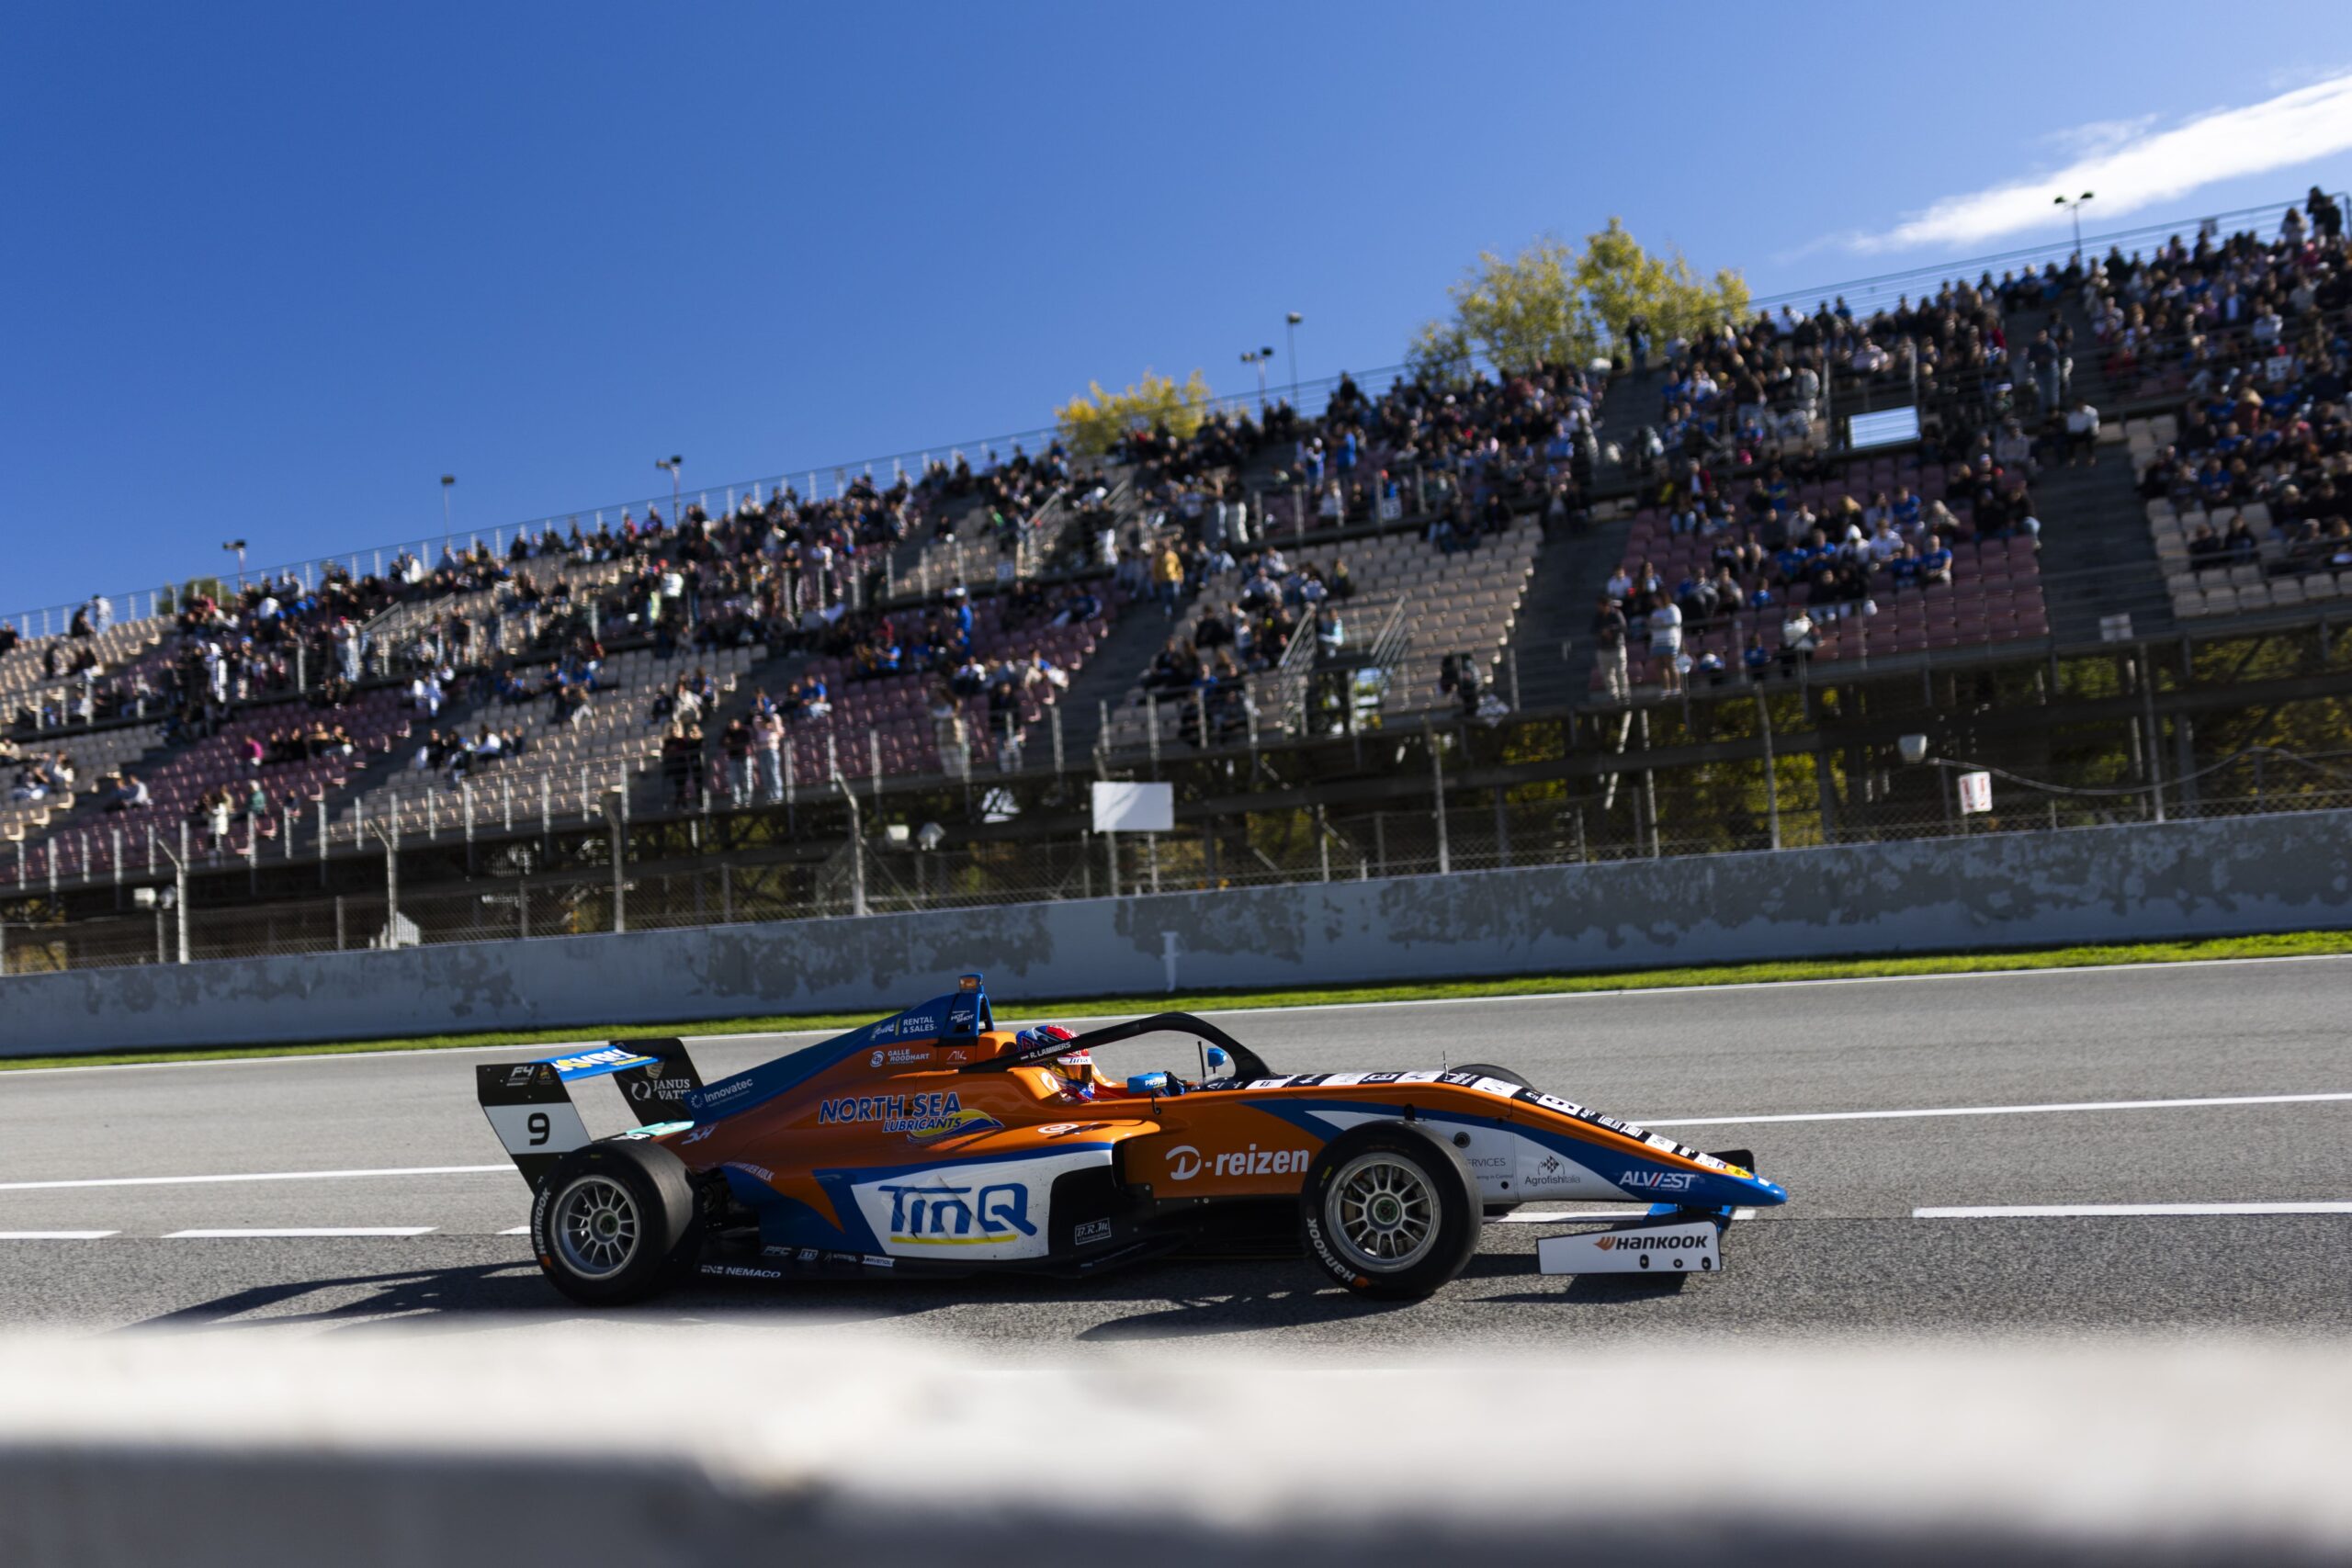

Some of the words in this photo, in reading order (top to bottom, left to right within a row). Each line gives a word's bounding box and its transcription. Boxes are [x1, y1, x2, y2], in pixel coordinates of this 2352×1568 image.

[903, 1016, 934, 1026] RENTAL
[910, 1023, 934, 1032] SALES
[1037, 1042, 1071, 1057] LAMMERS
[511, 1066, 535, 1077] F4
[653, 1078, 690, 1091] JANUS
[704, 1078, 753, 1103] Innovatec
[819, 1094, 905, 1123] NORTH
[912, 1091, 962, 1119] SEA
[527, 1111, 550, 1146] 9
[882, 1117, 963, 1134] LUBRICANTS
[726, 1266, 781, 1279] NEMACO
